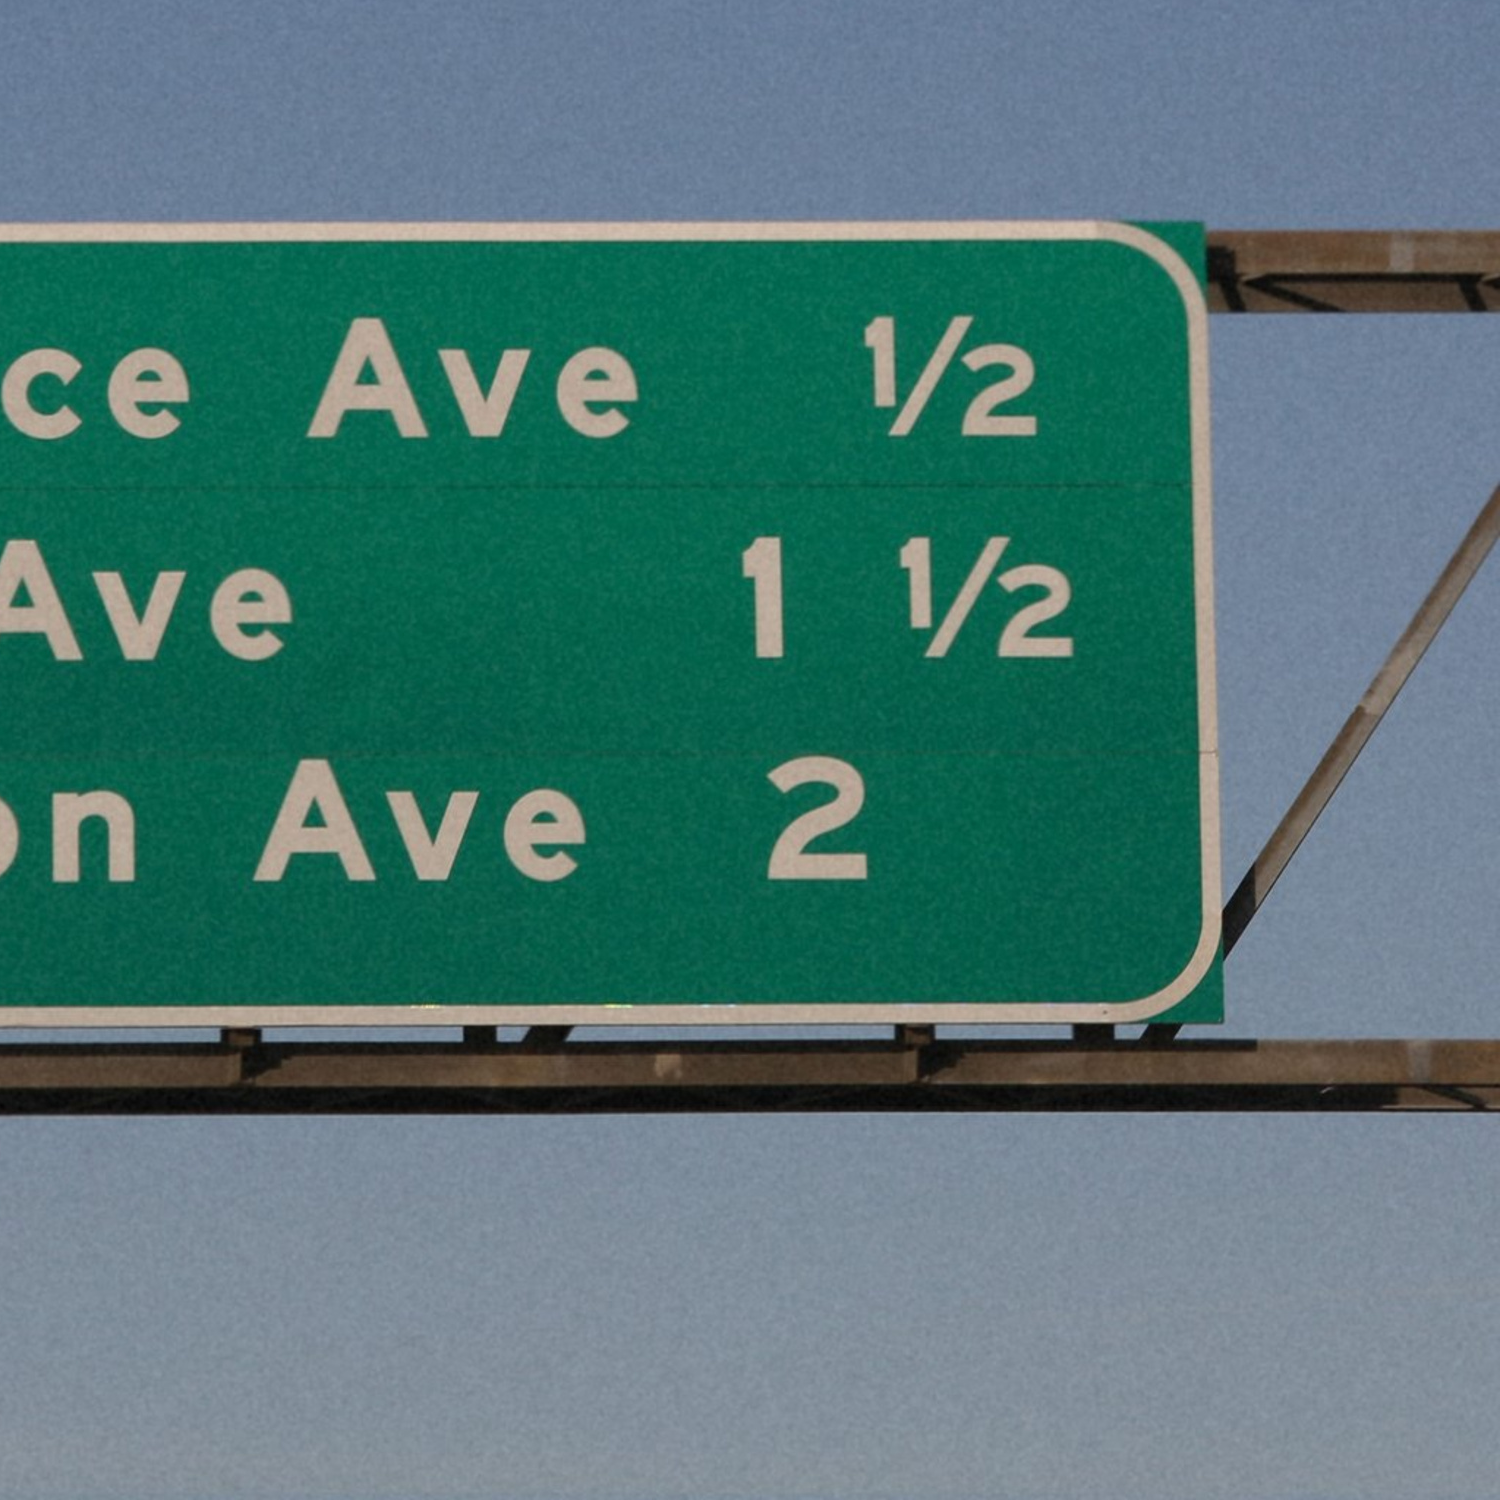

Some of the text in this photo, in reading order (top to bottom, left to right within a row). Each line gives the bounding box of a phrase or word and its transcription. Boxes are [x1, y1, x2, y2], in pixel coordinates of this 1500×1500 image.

[306, 316, 639, 438] Ave
[863, 315, 1038, 437] 1/2
[741, 535, 785, 658] 1
[899, 535, 1074, 658] 1/2
[253, 757, 587, 883] Ave
[767, 754, 869, 881] 2
